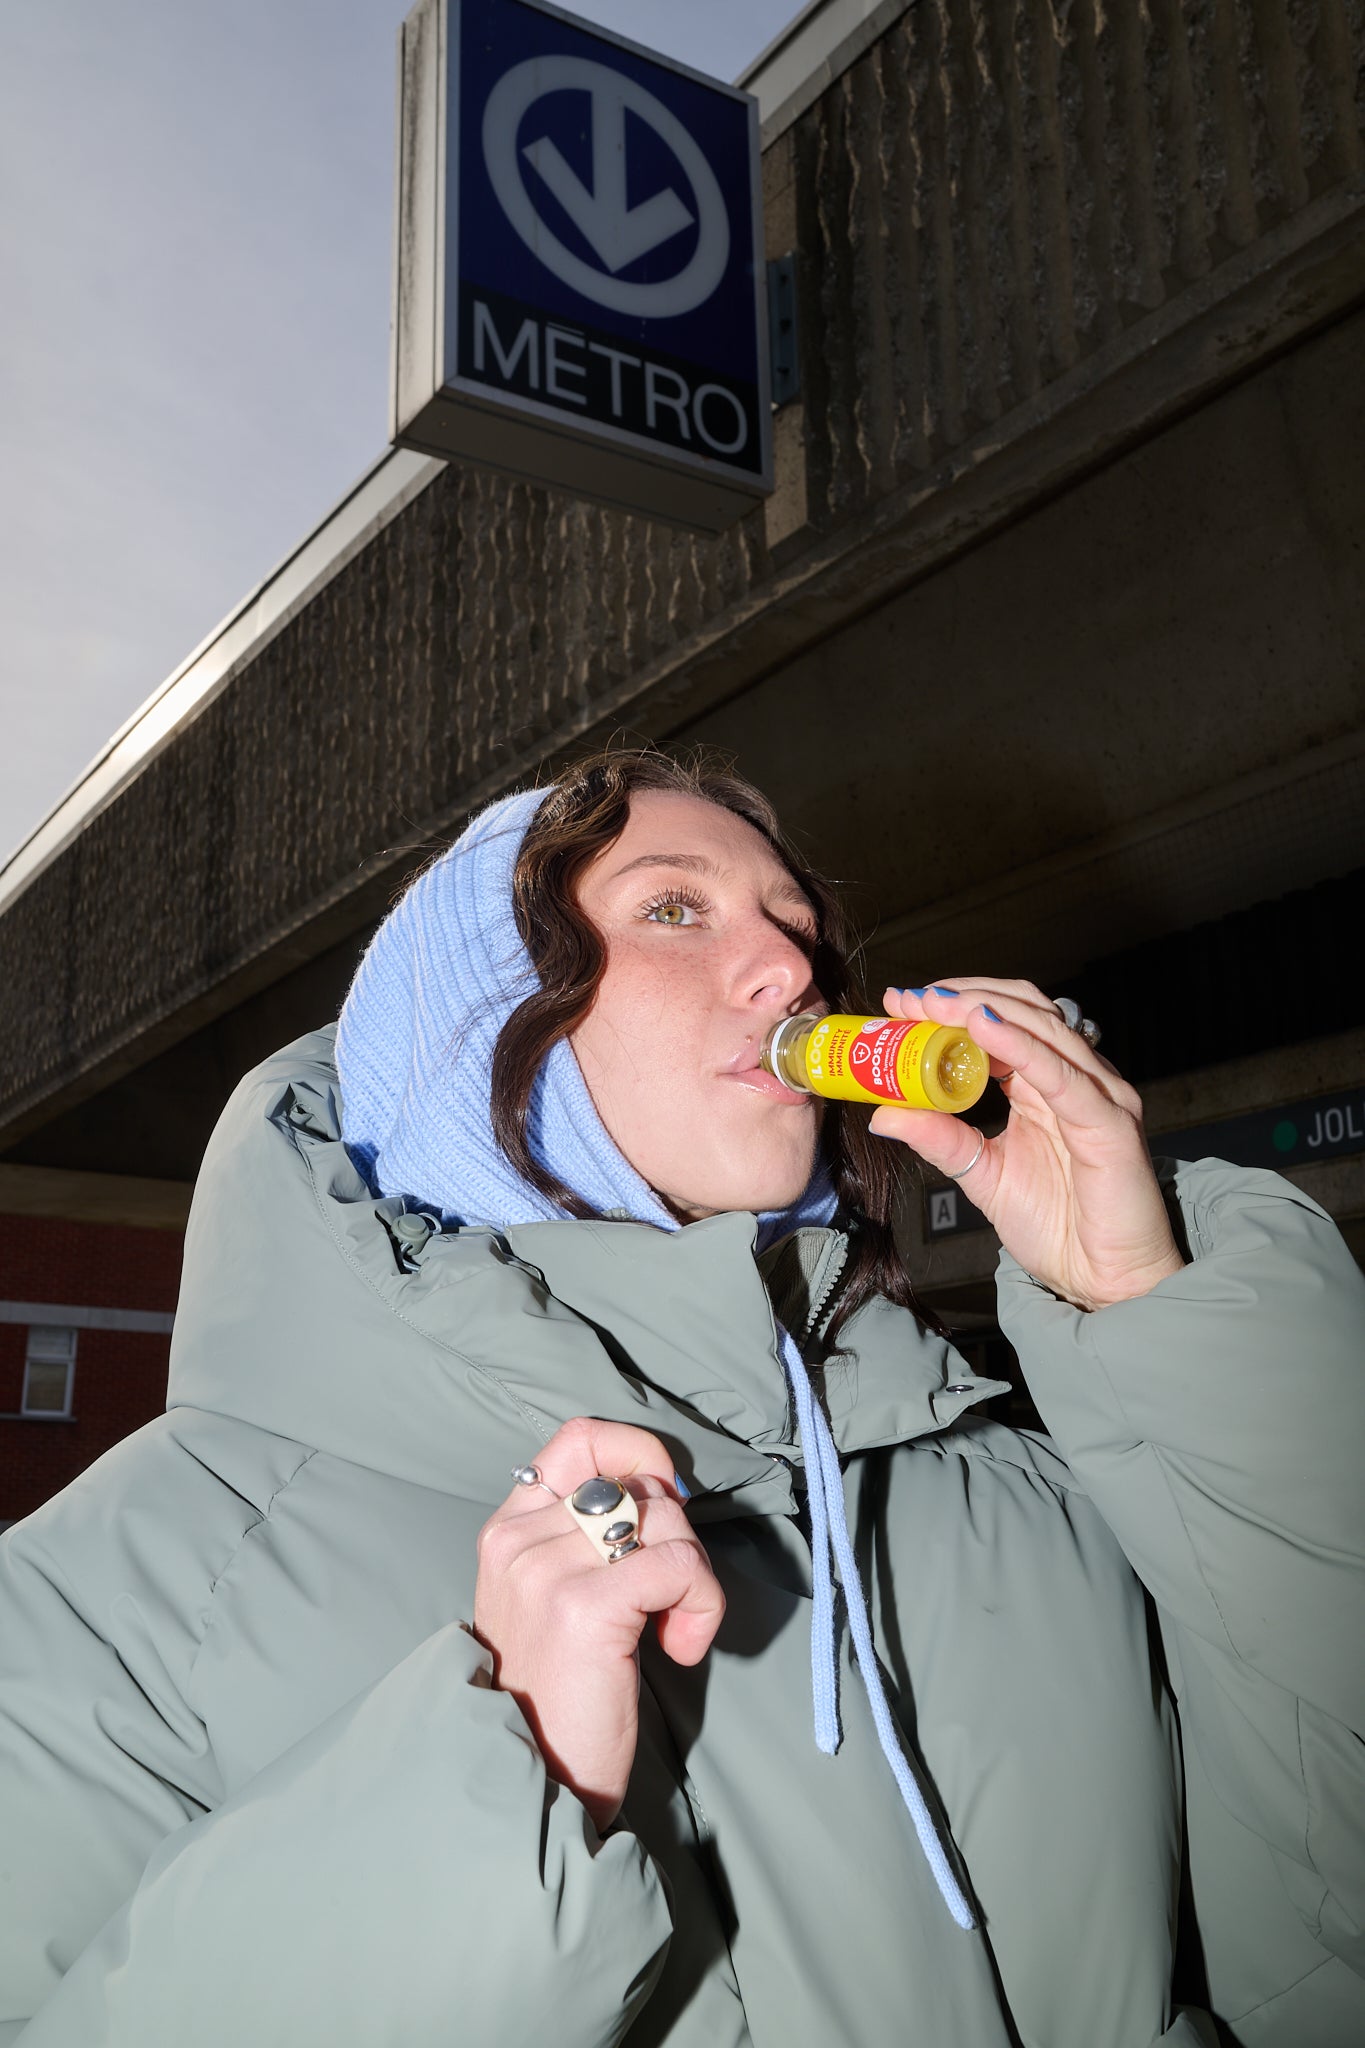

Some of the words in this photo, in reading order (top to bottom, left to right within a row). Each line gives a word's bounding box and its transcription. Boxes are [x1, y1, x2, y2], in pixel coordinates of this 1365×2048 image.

[810, 1024, 829, 1075] LOOP
[828, 1028, 842, 1076] IMMUNITY
[872, 1028, 893, 1085] BOOSTER
[1307, 1102, 1365, 1147] JOL
[937, 1198, 951, 1223] A
